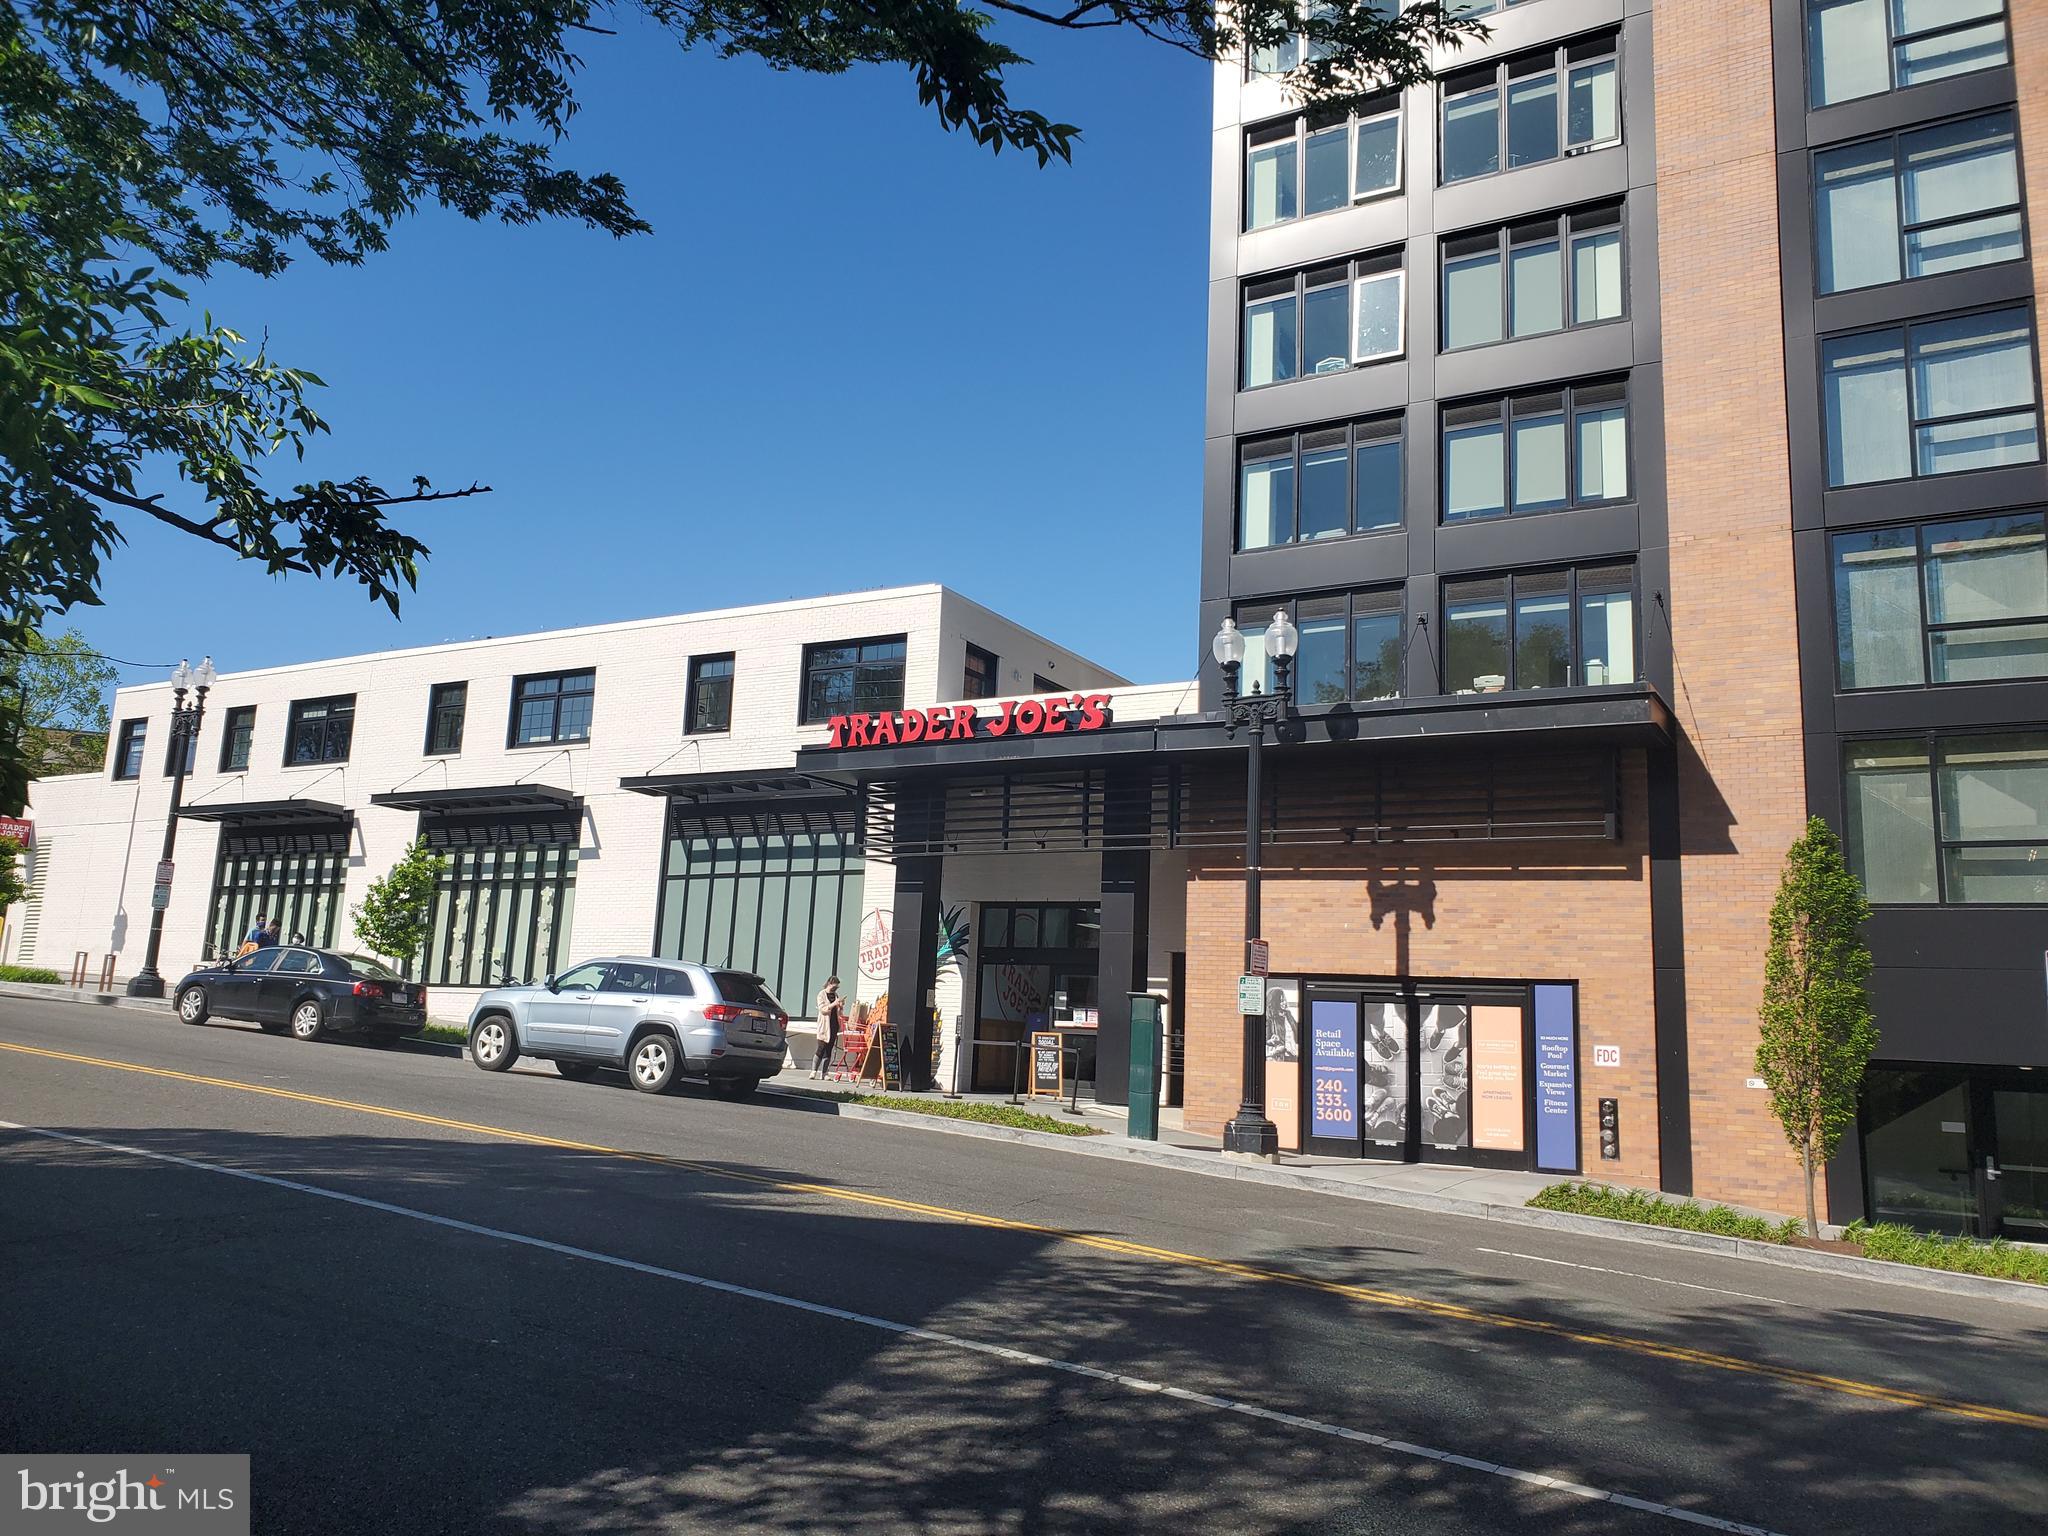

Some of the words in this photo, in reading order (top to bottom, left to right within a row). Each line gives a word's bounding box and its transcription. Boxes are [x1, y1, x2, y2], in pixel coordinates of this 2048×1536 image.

[827, 704, 978, 749] TRADER
[985, 693, 1113, 737] JOE'S
[860, 944, 891, 963] TRAD
[1315, 1029, 1341, 1039] Retail
[1315, 1038, 1341, 1050] Space
[1541, 1044, 1568, 1054] Rooftop
[1315, 1047, 1355, 1058] Available
[1597, 1049, 1617, 1062] FDC
[1540, 1062, 1570, 1071] Gourmet
[1543, 1070, 1568, 1078] Market
[1316, 1078, 1348, 1093] 240.
[1539, 1080, 1572, 1089] Expansive
[1545, 1088, 1566, 1096] Views
[1316, 1093, 1348, 1107] 333.
[1543, 1099, 1568, 1107] Fitness
[1316, 1107, 1352, 1122] 3600
[1544, 1106, 1569, 1114] Center
